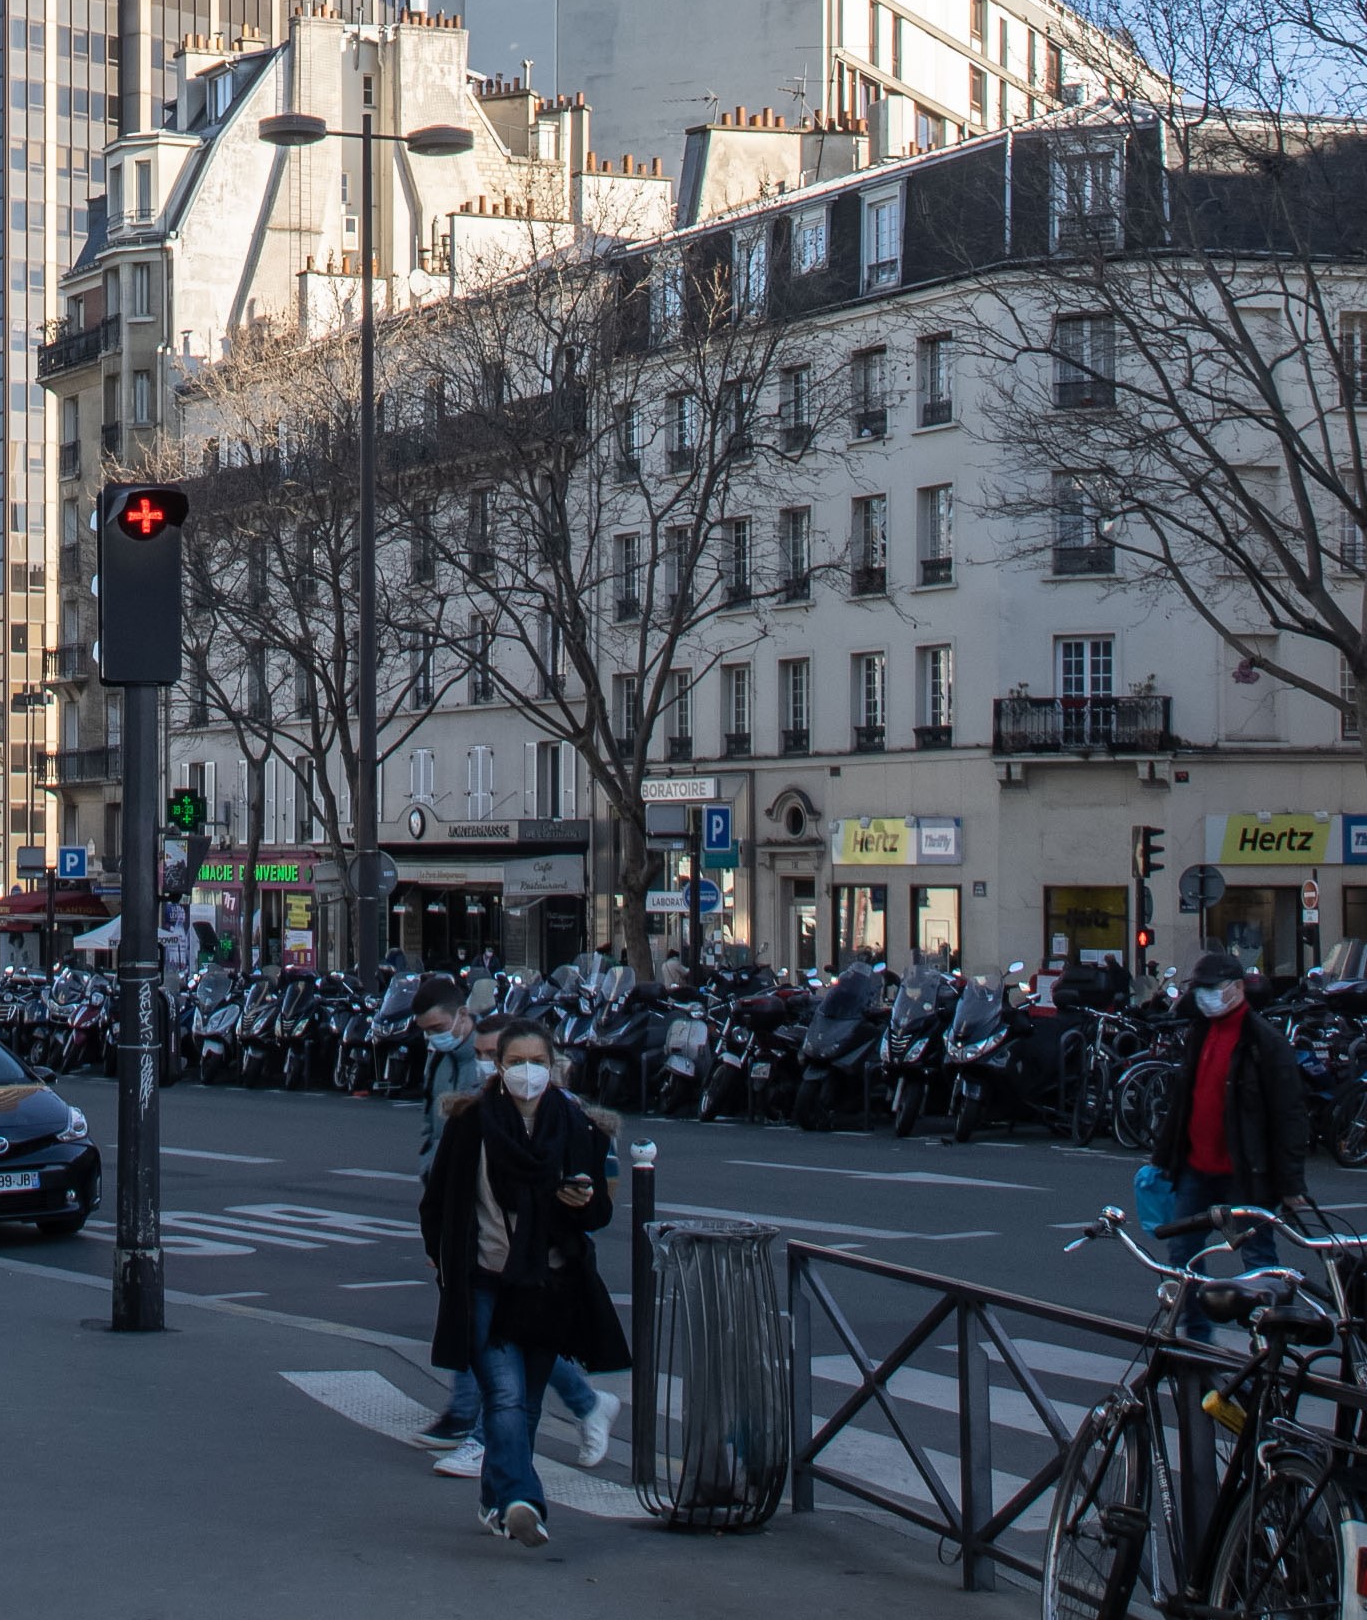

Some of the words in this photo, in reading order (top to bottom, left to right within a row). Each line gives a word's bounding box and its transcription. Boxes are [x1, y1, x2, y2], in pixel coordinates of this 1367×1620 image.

[642, 782, 706, 798] BORATOIRE
[712, 814, 724, 842] P
[852, 830, 899, 852] Hertz
[1238, 827, 1314, 851] Hertz
[66, 853, 79, 872] P
[533, 862, 553, 874] Café
[198, 864, 233, 881] MACIE
[239, 864, 299, 881] BNVENUE
[520, 881, 568, 891] Restaurant
